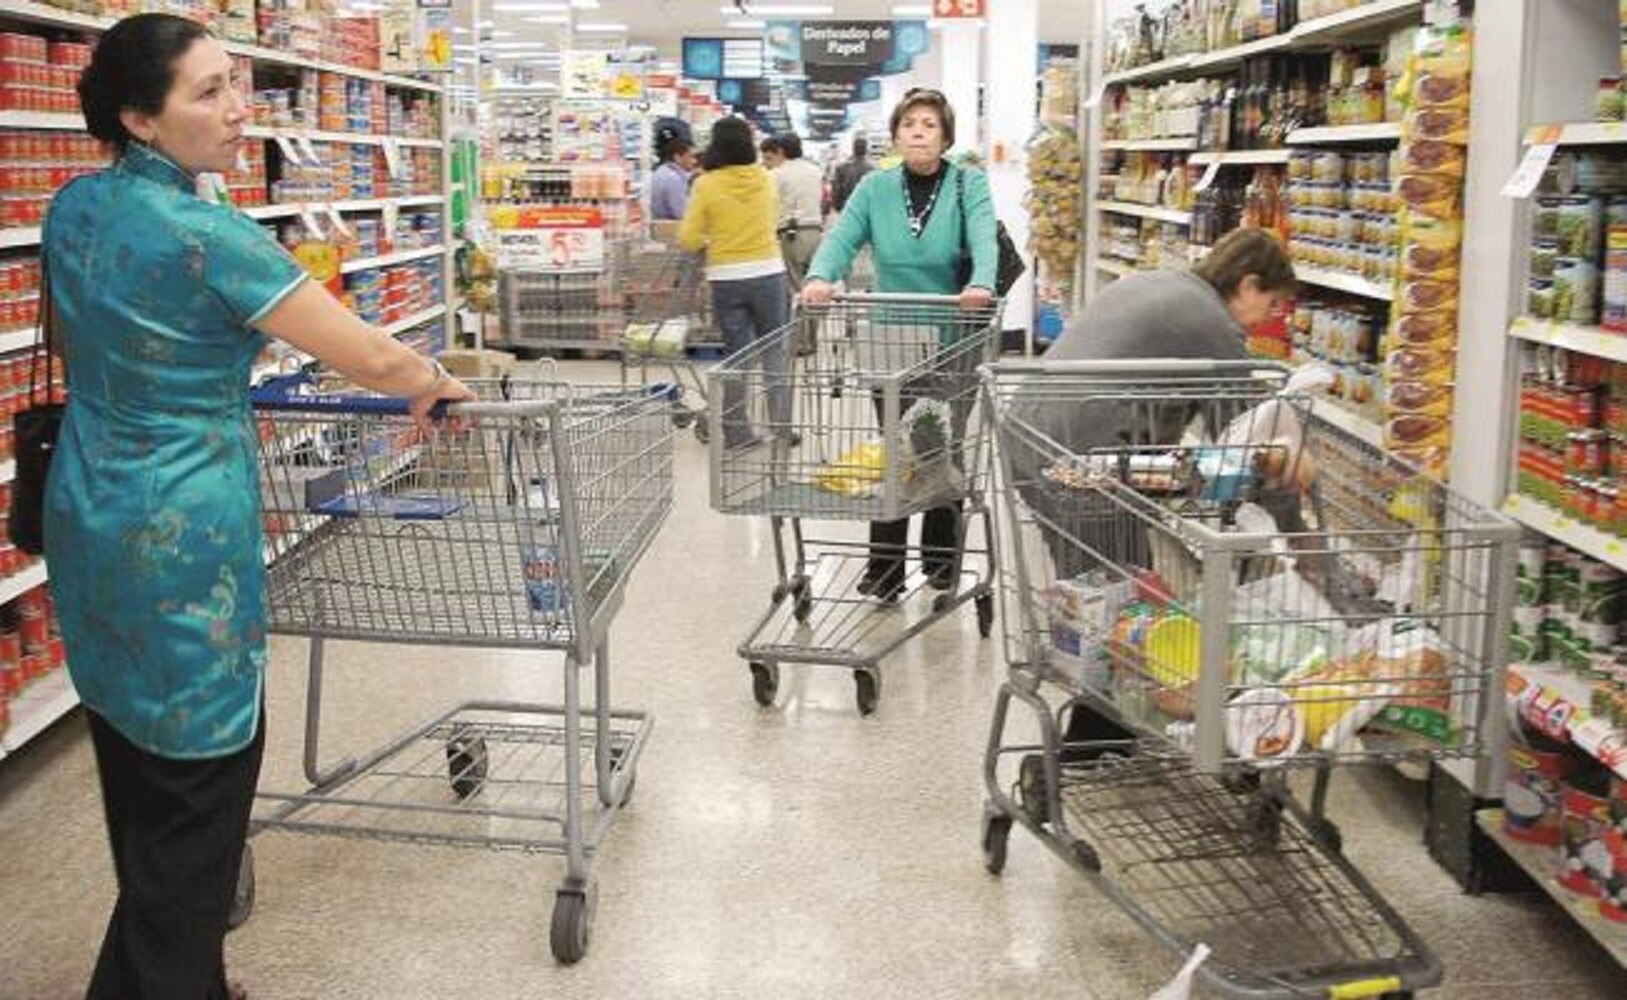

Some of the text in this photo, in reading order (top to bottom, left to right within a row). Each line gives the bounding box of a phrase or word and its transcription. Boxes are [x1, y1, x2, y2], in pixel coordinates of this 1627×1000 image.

[803, 26, 890, 40] Derivados de
[827, 39, 866, 56] Papel
